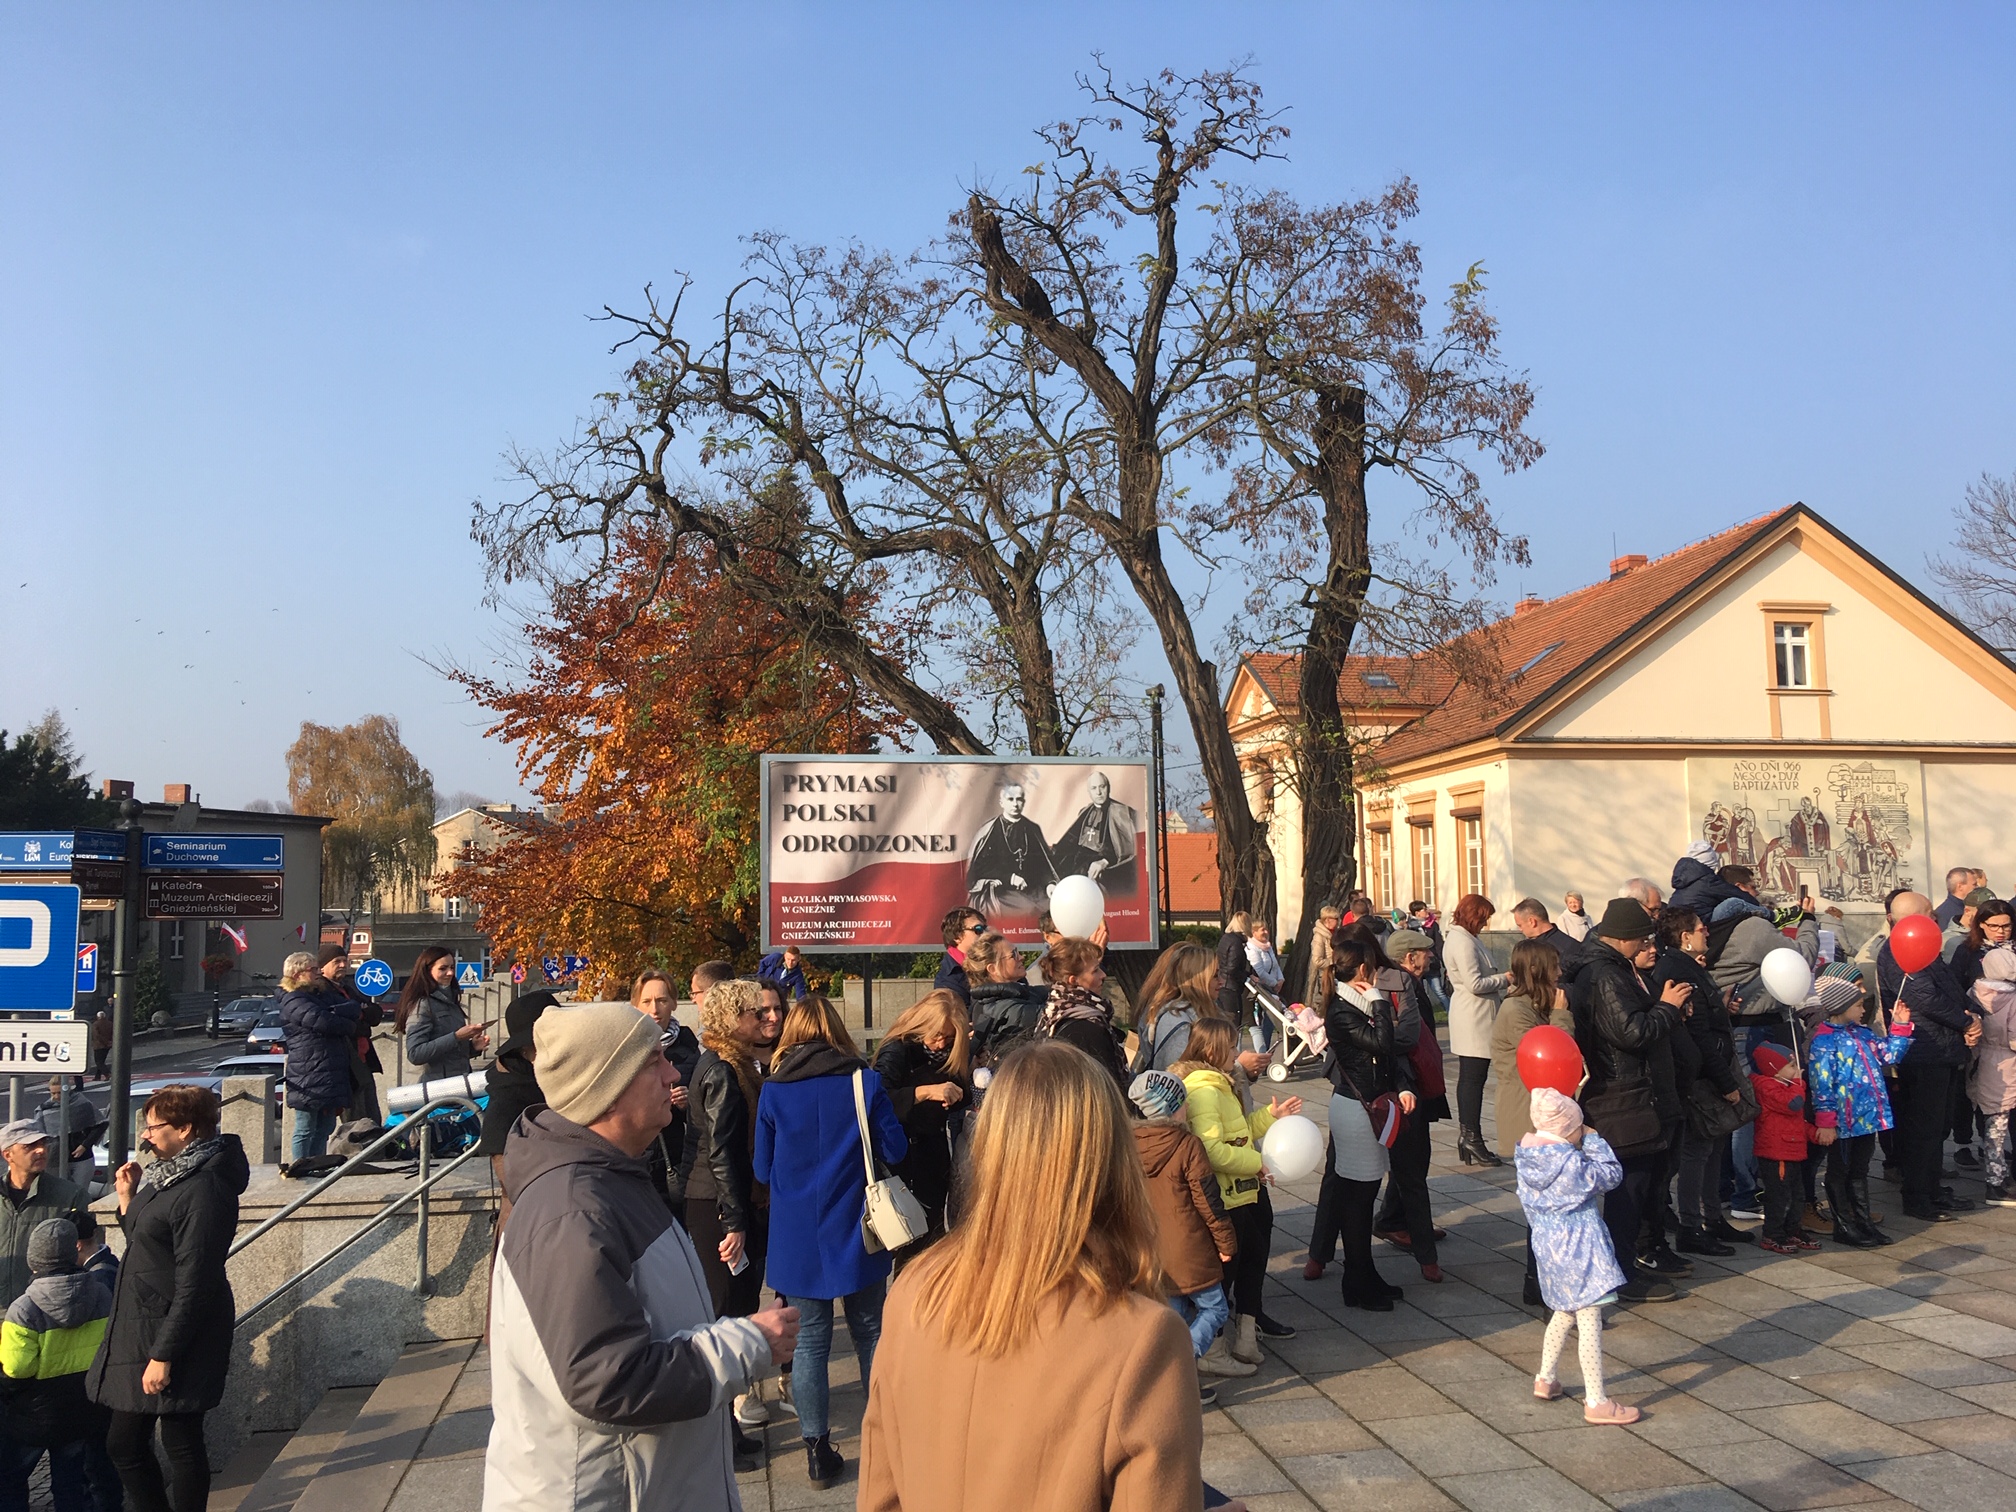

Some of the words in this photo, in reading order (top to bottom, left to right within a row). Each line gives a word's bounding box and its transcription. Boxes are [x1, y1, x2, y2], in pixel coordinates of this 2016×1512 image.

[1783, 762, 1801, 771] 966
[1779, 772, 1799, 780] DUX
[782, 774, 897, 793] PRYMASI
[1733, 781, 1799, 790] BAPTIZATUR
[782, 803, 877, 822] POLSKI
[166, 842, 227, 850] Seminarium
[781, 834, 957, 853] ODRODZONEJ
[166, 853, 219, 861] Duchowne
[162, 881, 202, 890] Katedra
[161, 893, 204, 901] Muzeum
[207, 893, 273, 903] Archidiecezji
[781, 895, 827, 904] BAZYLIKA
[828, 894, 897, 903] PRYMASOWSKA
[160, 904, 237, 914] Gnieźnieńskiej
[781, 906, 791, 914] W
[792, 904, 836, 914] GNIEŹNIE
[781, 921, 822, 930] MUZEUM
[823, 920, 892, 929] ARCHIDIECEZJI
[781, 930, 856, 940] GNIEŹNIEŃSKIEJ
